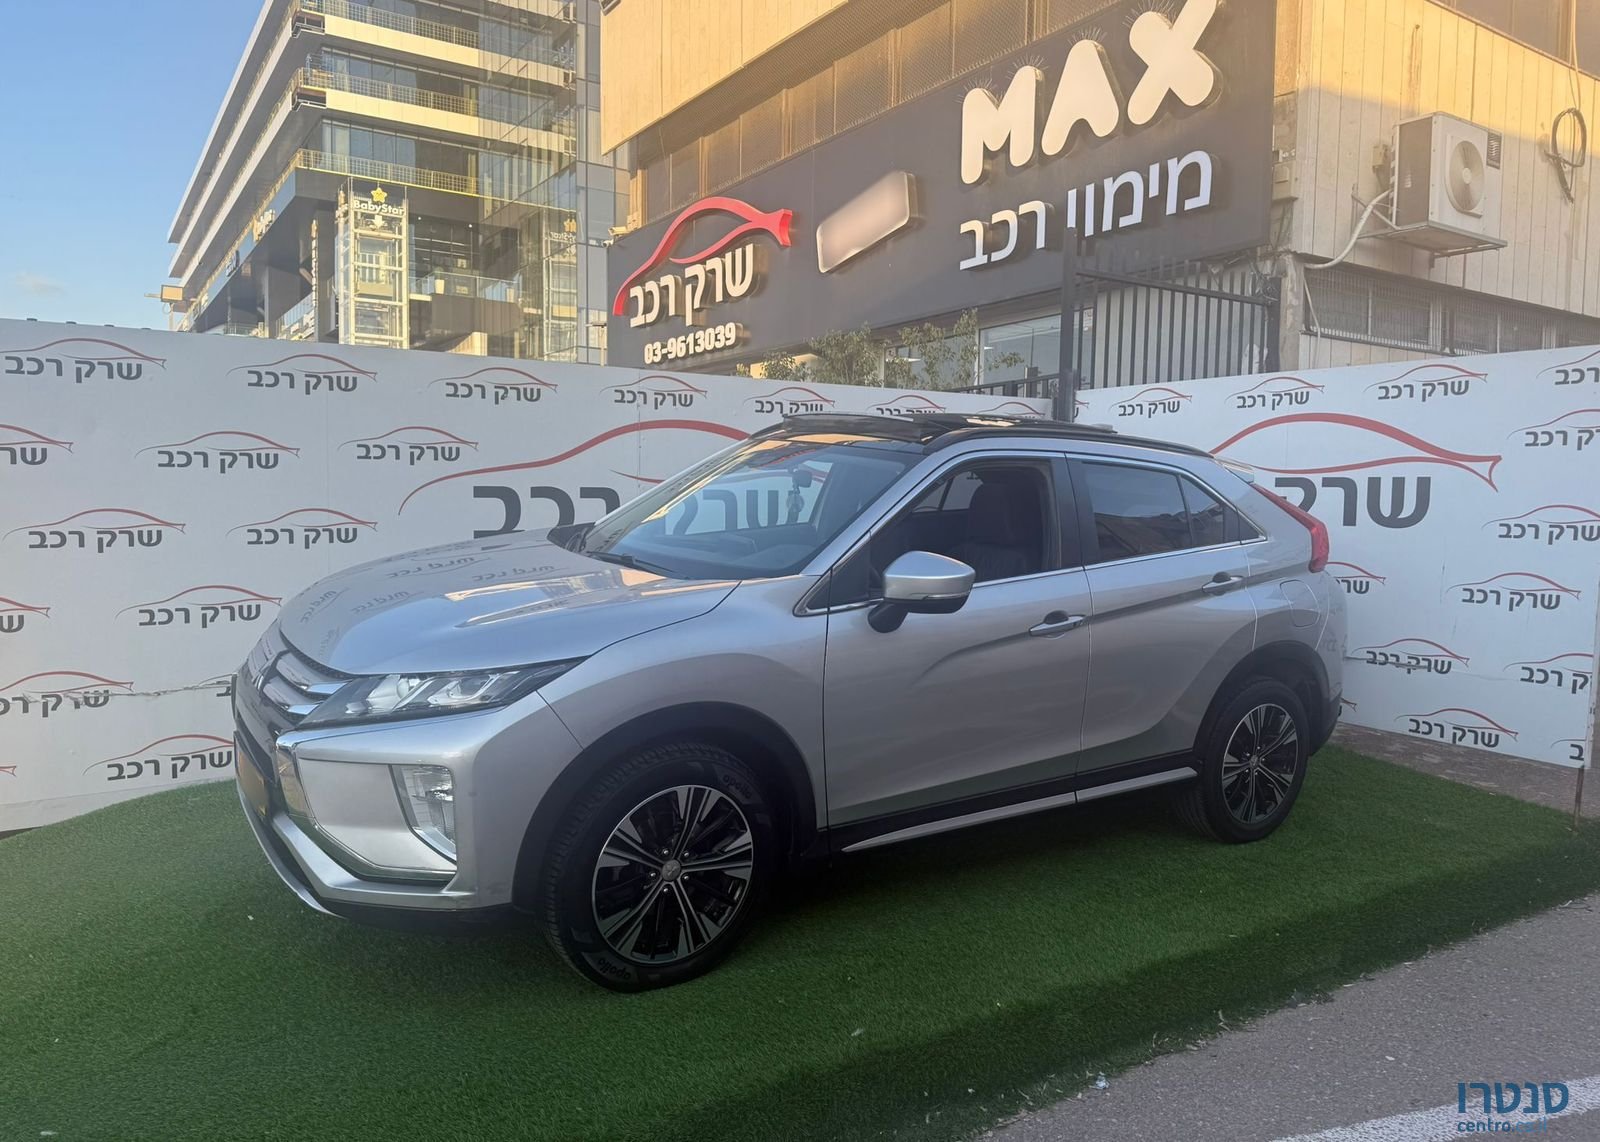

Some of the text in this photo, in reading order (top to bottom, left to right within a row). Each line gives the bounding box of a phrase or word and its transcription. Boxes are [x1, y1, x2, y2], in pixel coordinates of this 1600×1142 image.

[960, 0, 1218, 184] MAX
[354, 198, 405, 216] BabyStar
[959, 200, 1046, 271] רכב
[630, 243, 754, 328] שרק רכב
[644, 322, 736, 364] 03-9613039
[5, 356, 143, 383] שרק רכב
[1555, 367, 1600, 386] רכב
[248, 370, 358, 395] שרק רכב
[445, 382, 541, 405] שרק רכב
[1378, 380, 1470, 402] שרק רכב
[614, 389, 694, 410] שרק רכב
[755, 400, 784, 414] רכב
[1118, 400, 1180, 418] שרק רכב
[1237, 391, 1310, 411] שרק רכב
[1525, 430, 1568, 447] רכב
[0, 447, 47, 465] שר
[158, 449, 279, 473] שרק רכב
[357, 444, 460, 465] שרק רכב
[28, 530, 162, 553] שרק רכב
[247, 527, 358, 549] שרק רכב
[1498, 523, 1600, 545] שרק רכב
[1336, 579, 1370, 595] שר
[1462, 588, 1561, 611] שרק רכב
[138, 603, 261, 629] שרק רכב
[1366, 650, 1452, 675] שרק רכב
[1520, 666, 1563, 687] רכב
[0, 690, 109, 718] שרק רכ
[1408, 718, 1500, 748] שרק רכב
[107, 750, 233, 781] שרק רכב
